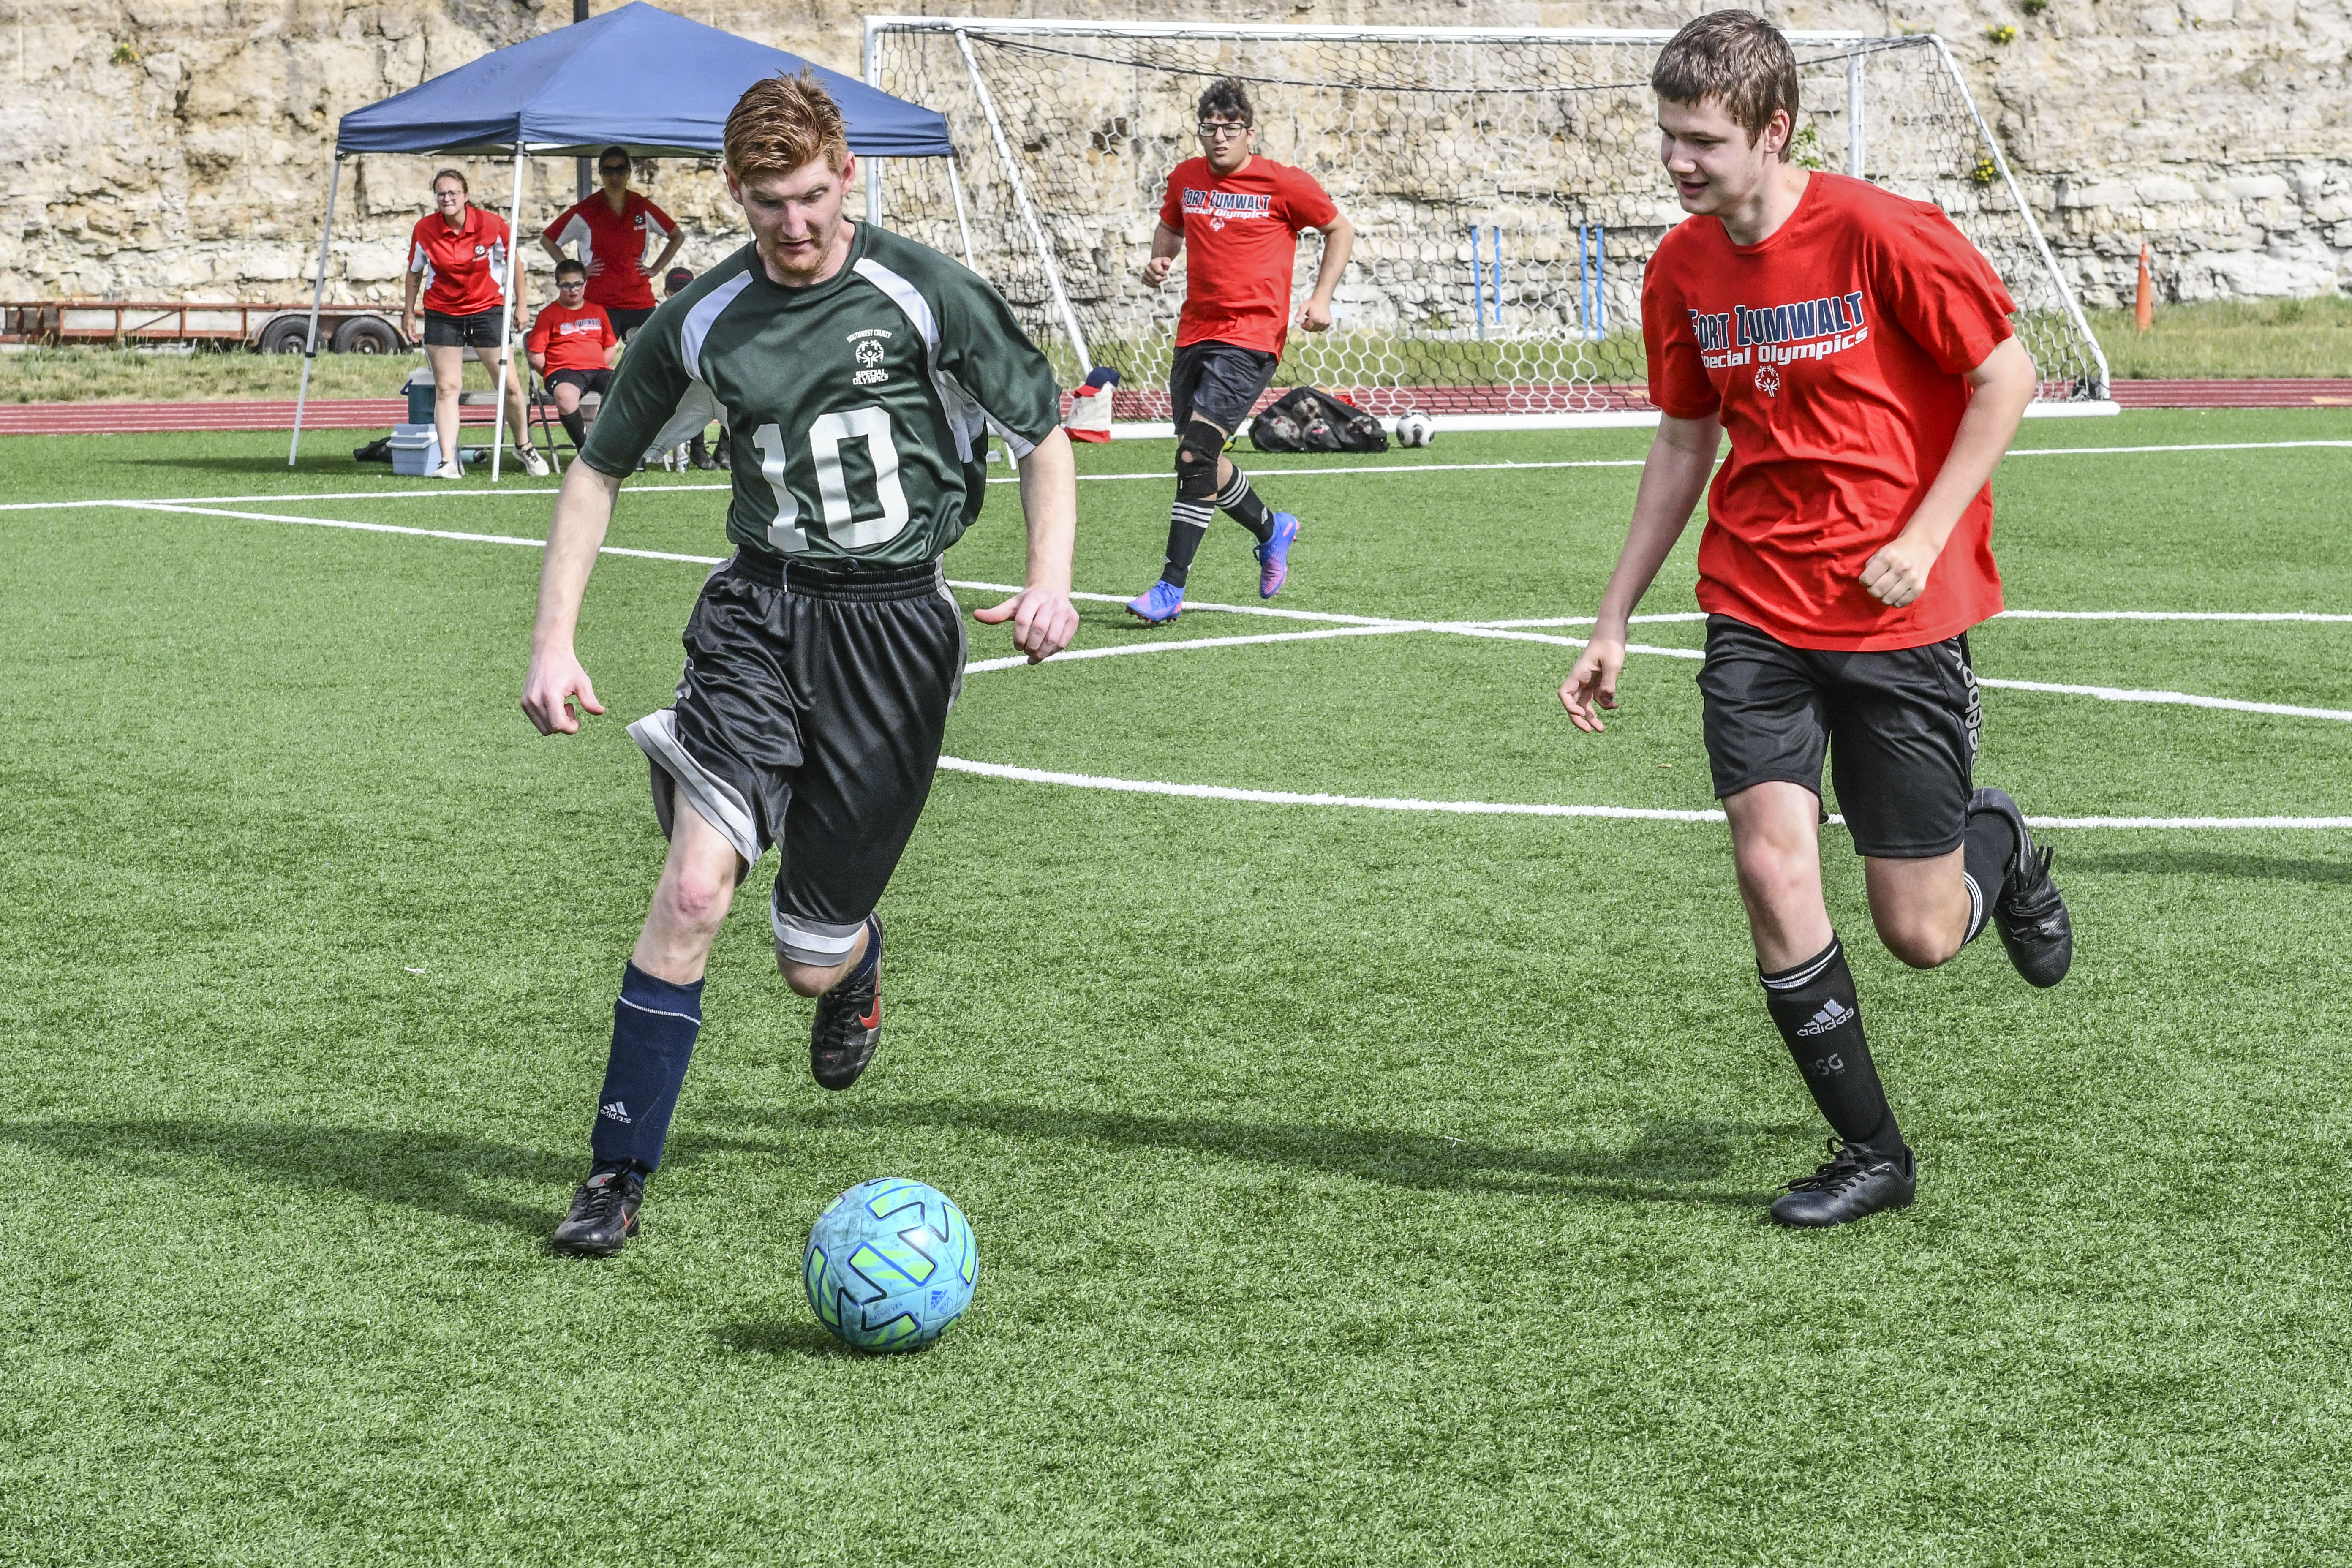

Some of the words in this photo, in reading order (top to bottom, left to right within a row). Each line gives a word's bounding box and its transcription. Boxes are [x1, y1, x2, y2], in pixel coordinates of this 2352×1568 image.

[1182, 187, 1207, 206] FORT
[1209, 190, 1271, 211] ZUMWALT
[1214, 208, 1270, 219] Olympics
[1688, 309, 1729, 351] FORT
[1734, 291, 1865, 346] ZUMWALT
[846, 329, 874, 343] SOUTHWEST
[874, 329, 892, 339] COUNTY
[1700, 347, 1751, 369] pecial
[1758, 327, 1868, 365] Olympics
[852, 373, 889, 385] OLYMPICS
[855, 369, 886, 378] SPECIAL
[751, 406, 909, 552] 10
[1797, 1005, 1854, 1037] adidas
[600, 1109, 632, 1123] adidas
[931, 1290, 948, 1310] adidas
